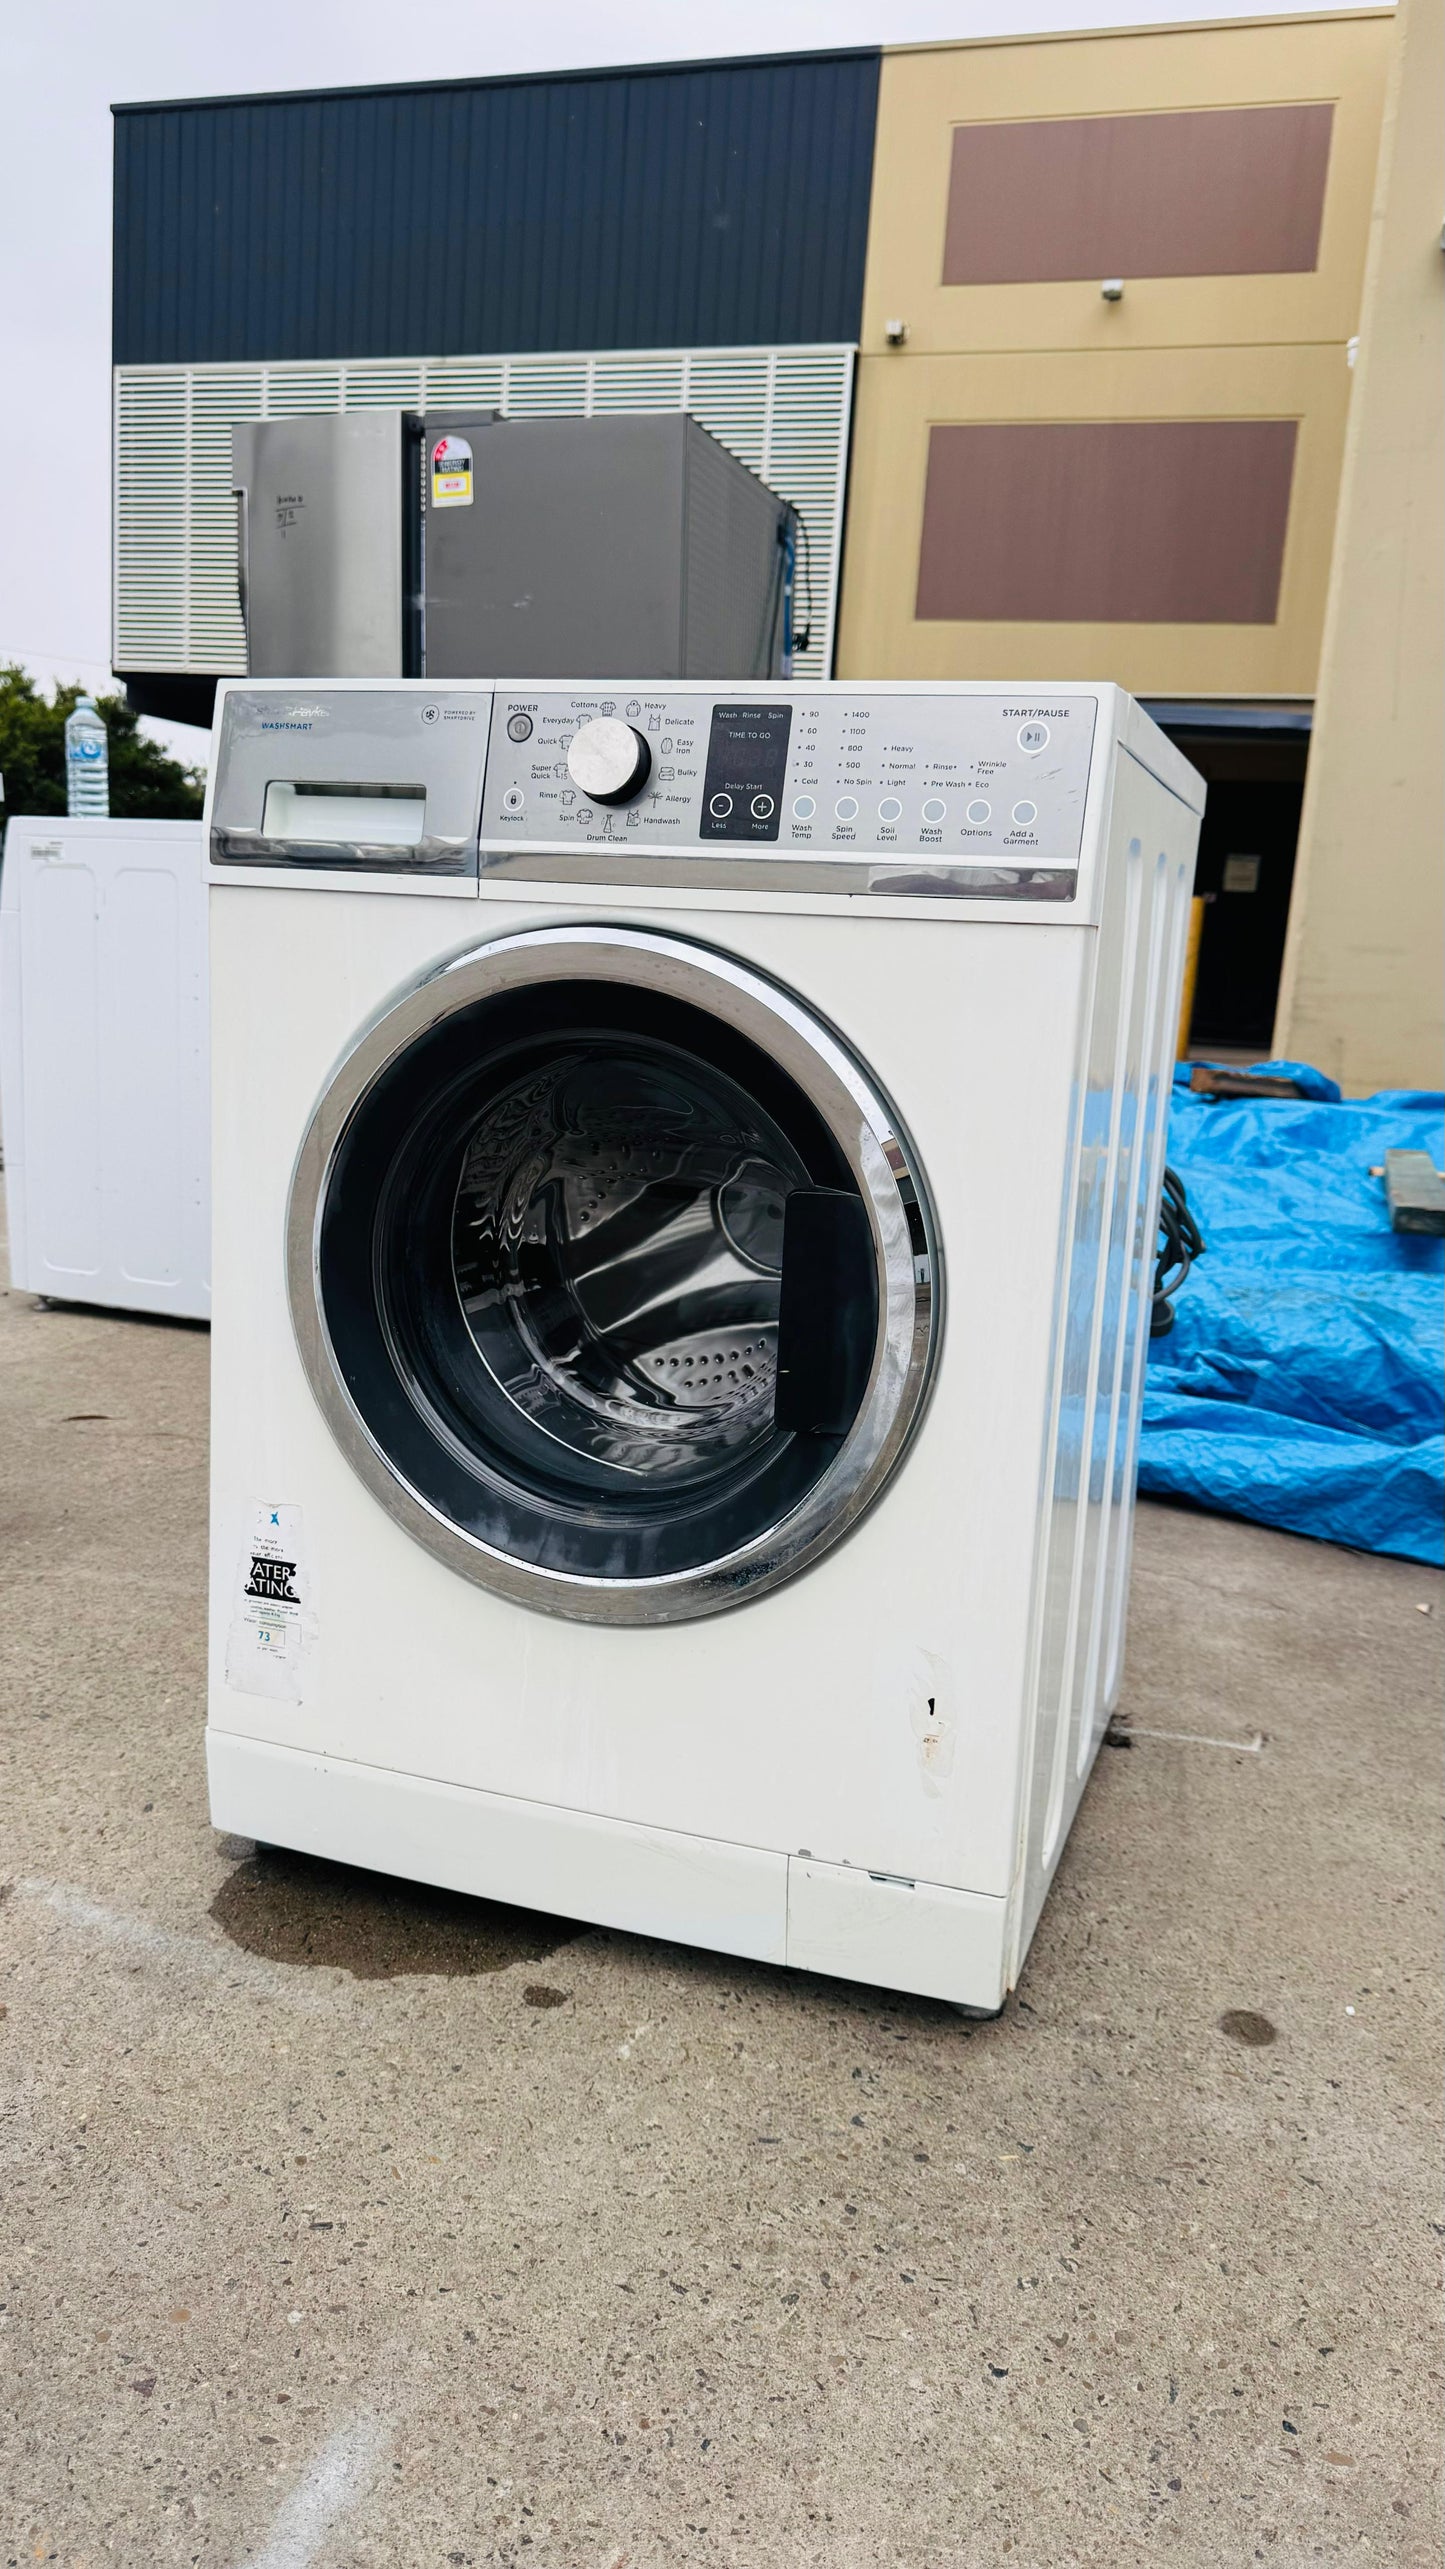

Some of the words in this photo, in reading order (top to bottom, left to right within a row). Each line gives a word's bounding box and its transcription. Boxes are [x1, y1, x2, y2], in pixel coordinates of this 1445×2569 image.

[507, 704, 539, 712] POWER
[644, 702, 667, 710] Heavy
[767, 712, 784, 720] Spin
[1002, 709, 1070, 718] START/PAUSE
[542, 717, 574, 726] Everyday
[664, 718, 695, 726] Delicate
[262, 722, 313, 730] WASHSMART
[728, 731, 746, 739] TIME
[677, 738, 694, 747] Easy
[676, 747, 691, 755] Iron
[891, 745, 914, 753] Heavy
[531, 764, 552, 772] Super
[977, 760, 1007, 768] Wrinkle
[677, 768, 698, 777] Bulky
[724, 782, 744, 790] Delay
[856, 778, 872, 786] Spin
[887, 779, 906, 787] Light
[539, 791, 558, 799] Rinse
[665, 794, 692, 804] Allergy
[559, 814, 575, 822] Spin
[643, 817, 681, 825] Handwash
[835, 825, 853, 833] Spin
[880, 826, 895, 834] Soil
[921, 827, 943, 835] Wash
[960, 828, 993, 837] Options
[607, 834, 628, 842] Clean
[791, 831, 812, 839] Temp
[831, 832, 856, 840] Speed
[1009, 830, 1027, 838] Add
[919, 835, 942, 843] Boost
[1003, 837, 1039, 846] Garment
[252, 1562, 291, 1580] ATER
[244, 1577, 296, 1598] ATING
[258, 1630, 270, 1642] 73
